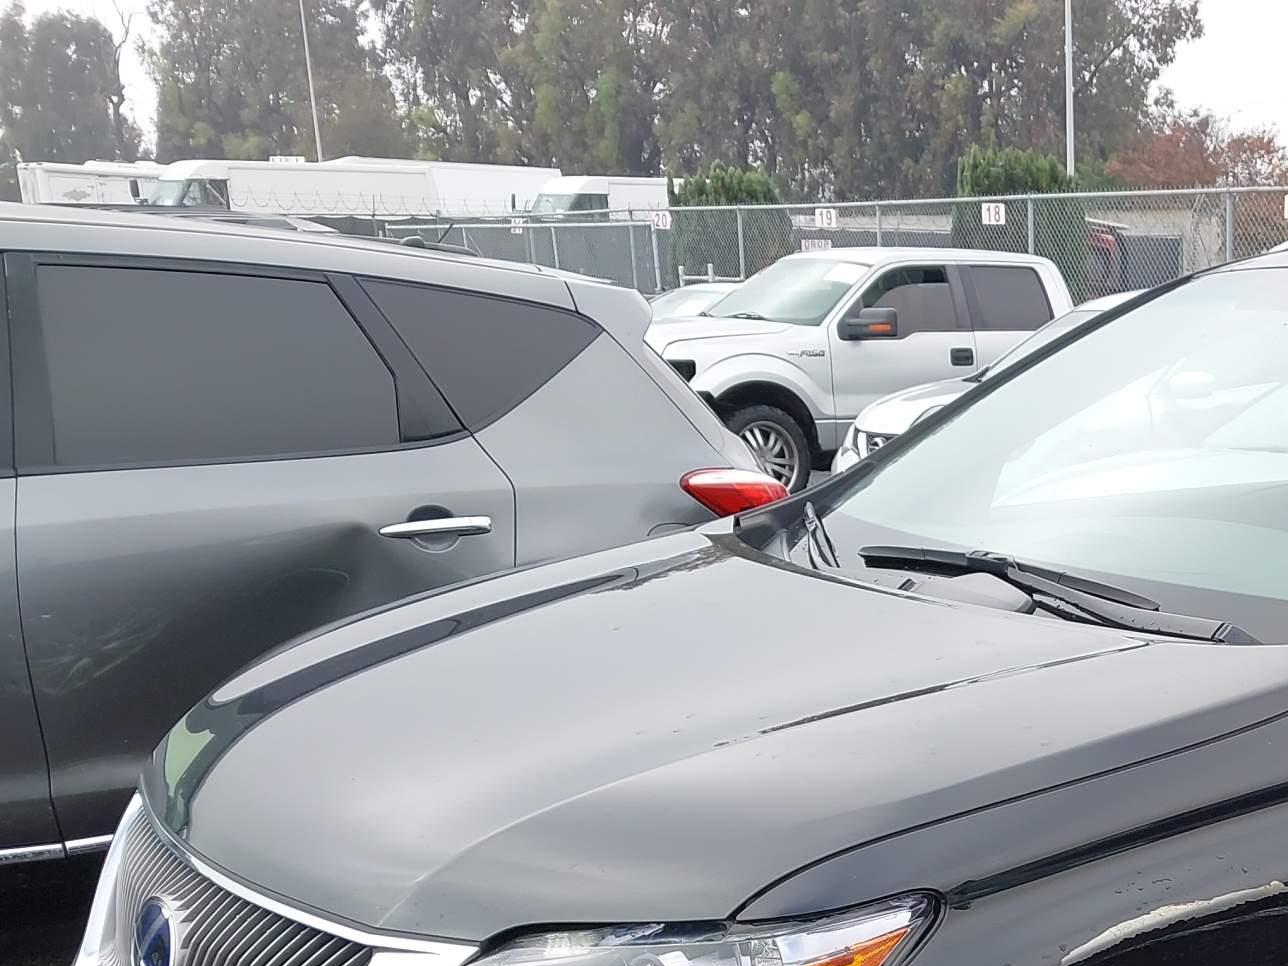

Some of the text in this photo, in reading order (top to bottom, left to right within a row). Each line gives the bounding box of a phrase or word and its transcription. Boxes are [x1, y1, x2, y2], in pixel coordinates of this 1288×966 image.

[654, 213, 668, 227] 20
[819, 210, 833, 227] 19
[986, 205, 1001, 223] 18
